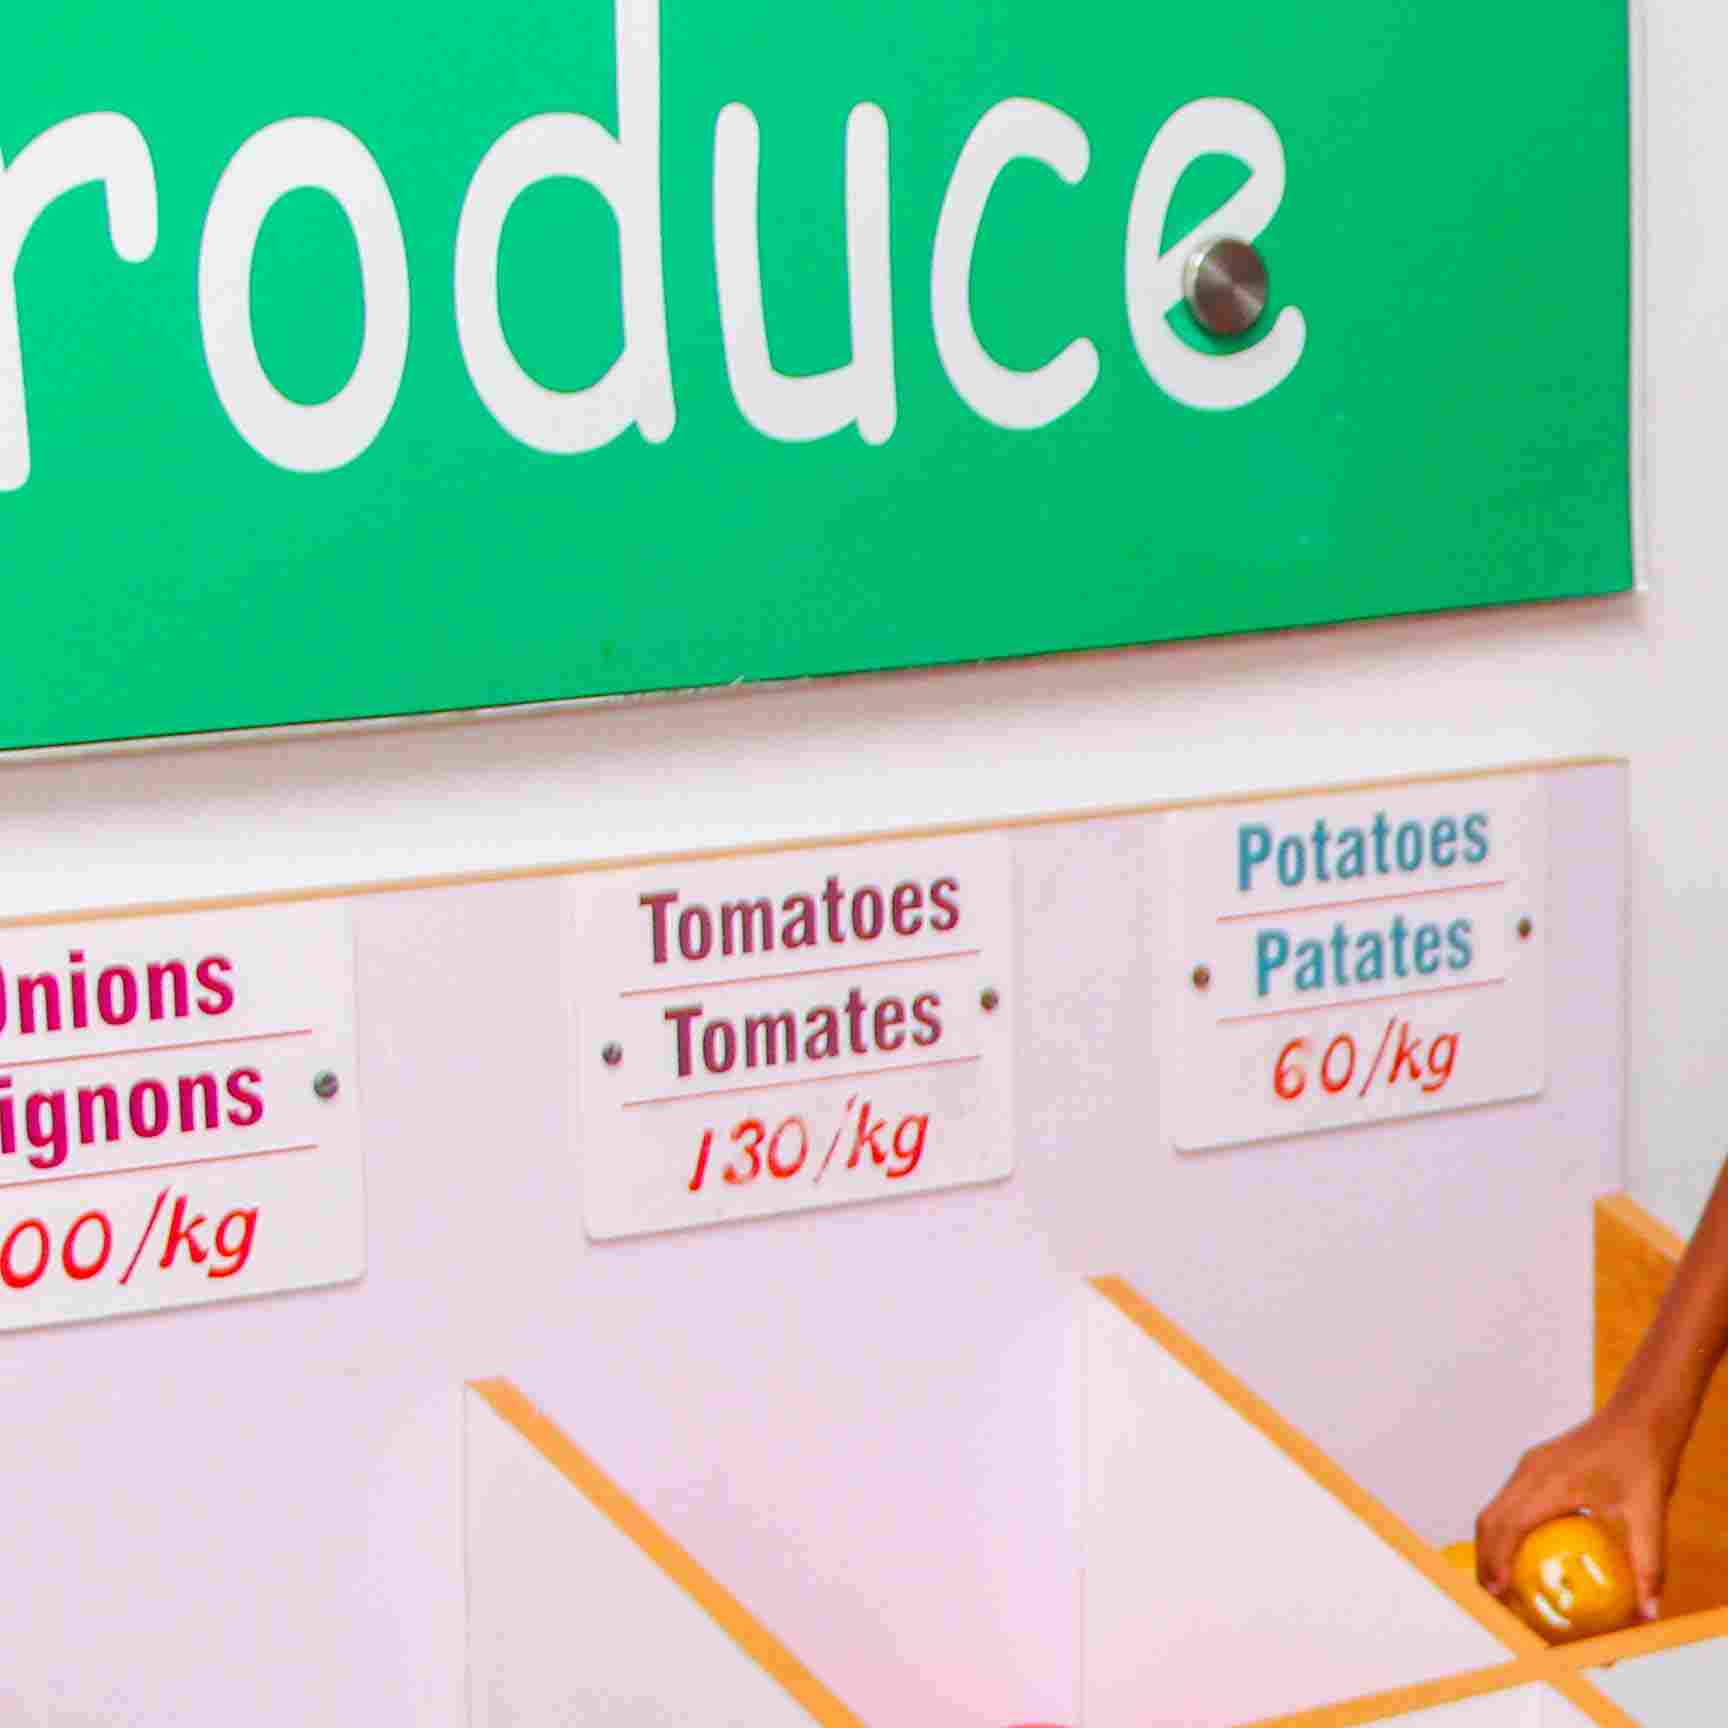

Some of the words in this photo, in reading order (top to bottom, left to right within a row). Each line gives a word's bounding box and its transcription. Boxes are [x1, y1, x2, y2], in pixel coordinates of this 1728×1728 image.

[0, 0, 1308, 492] roduce
[1237, 810, 1489, 892] Potatoes
[639, 874, 960, 965] Tomatoes
[1256, 915, 1473, 998] Patates
[0, 949, 235, 1035] nions
[664, 987, 943, 1078] Tomates
[1273, 1016, 1460, 1100] 60/kg
[0, 1066, 265, 1169] ignons
[688, 1092, 930, 1192] 130/kg
[0, 1185, 260, 1289] 00/kg
